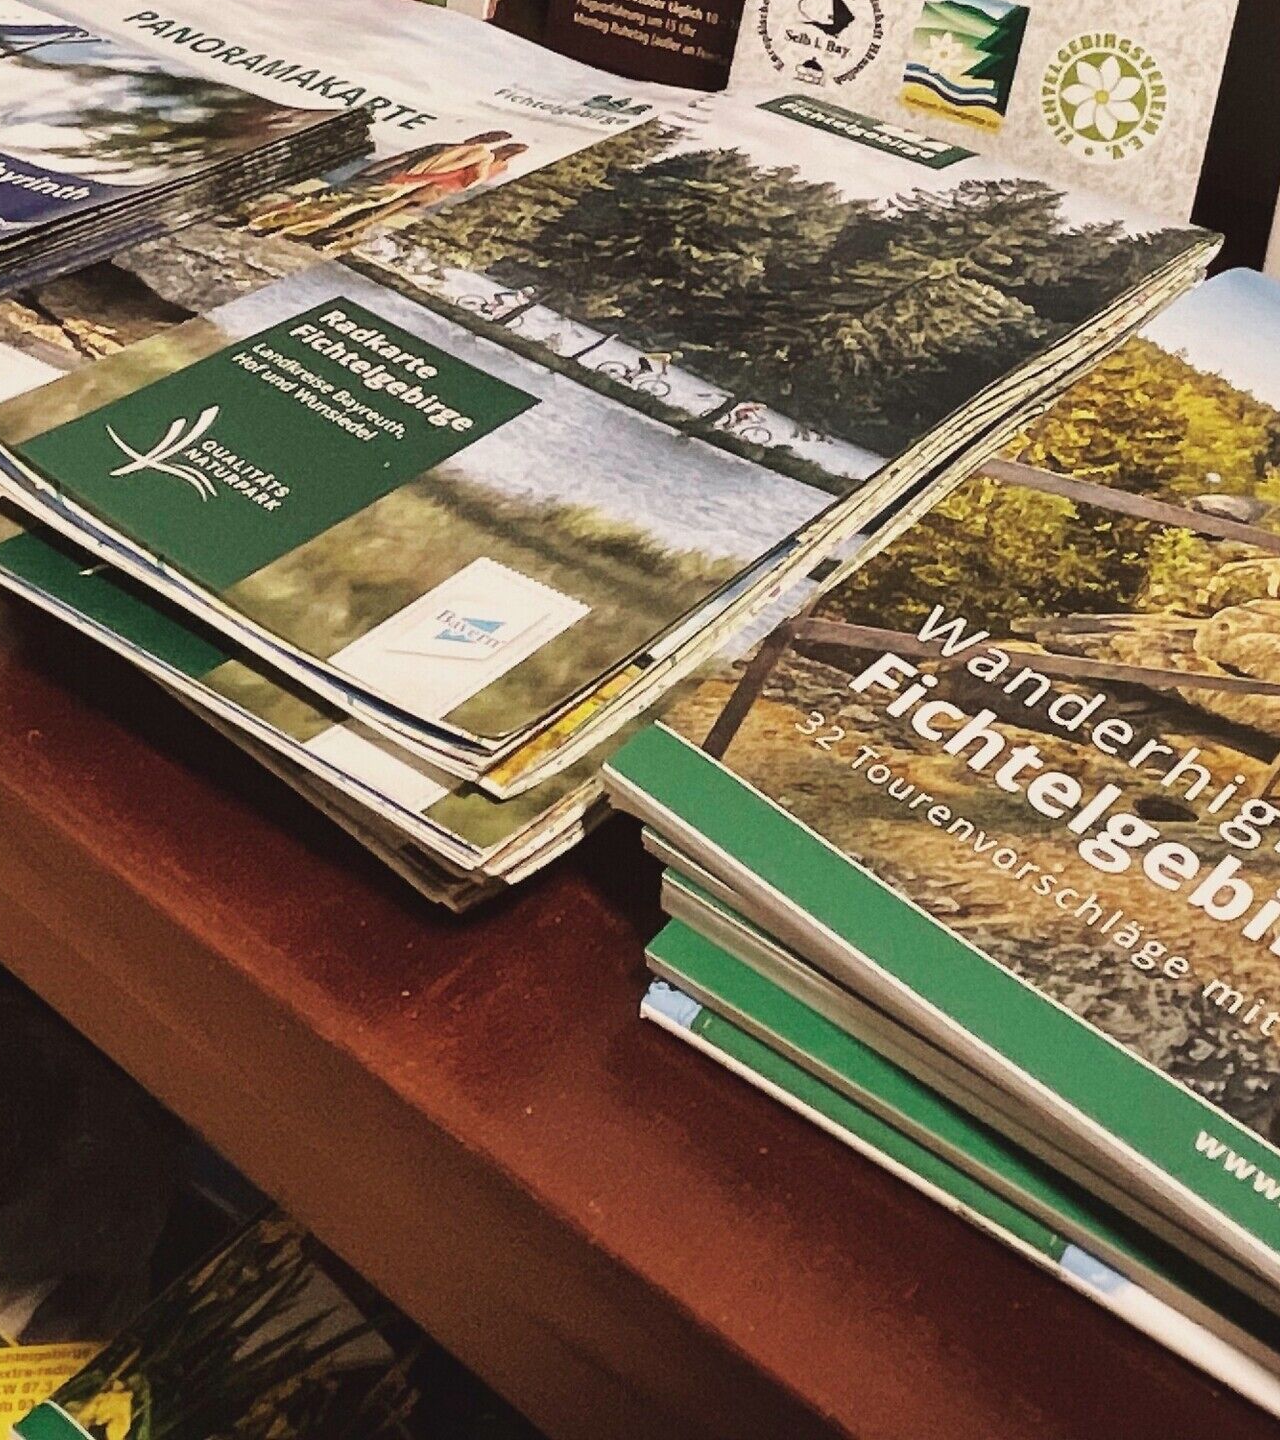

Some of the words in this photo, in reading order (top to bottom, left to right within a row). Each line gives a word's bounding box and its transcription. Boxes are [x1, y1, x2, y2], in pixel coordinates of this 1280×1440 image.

[123, 9, 440, 133] PANORAMAKARTE
[251, 342, 336, 395] Landkreise
[331, 389, 407, 441] Bayreuth,
[288, 323, 475, 433] Fichtelgebirge
[318, 309, 440, 380] Radkarte
[231, 351, 264, 373] Hof
[262, 370, 299, 393] und
[293, 387, 380, 442] Wunsiedel
[184, 448, 282, 512] NATURPARK
[201, 440, 291, 498] QUALITÄTS
[793, 709, 849, 752] 32
[850, 744, 1189, 982] Tourenvorschläge
